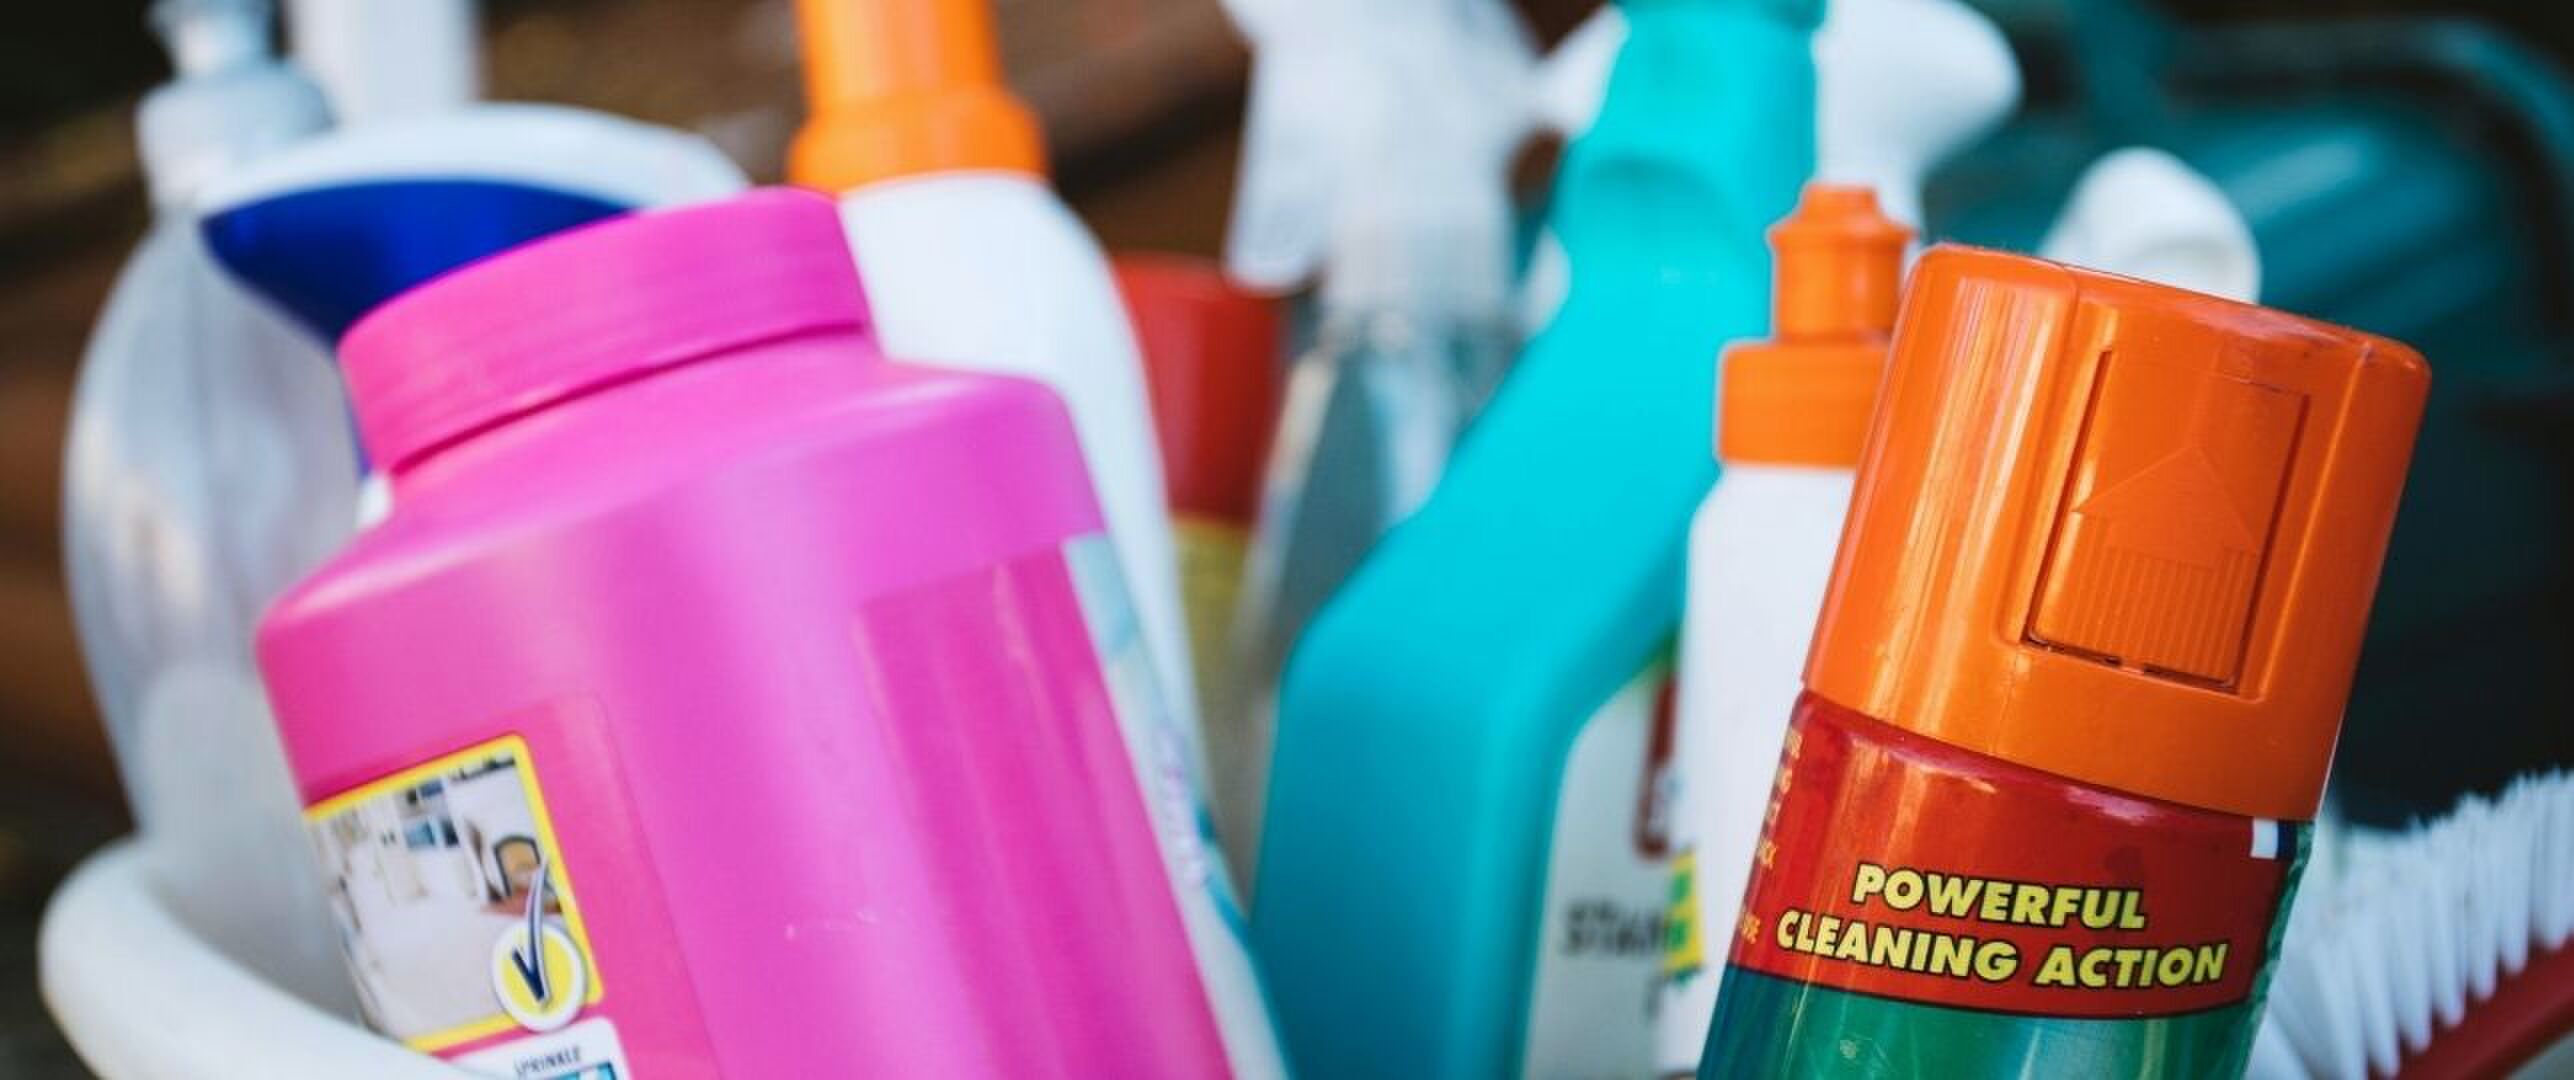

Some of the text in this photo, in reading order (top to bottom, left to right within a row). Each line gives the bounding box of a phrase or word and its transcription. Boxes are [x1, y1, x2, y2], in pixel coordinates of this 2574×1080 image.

[1851, 862, 2147, 930] POWERFUL
[1775, 908, 2019, 982] CLEANING
[2033, 942, 2229, 988] ACTION
